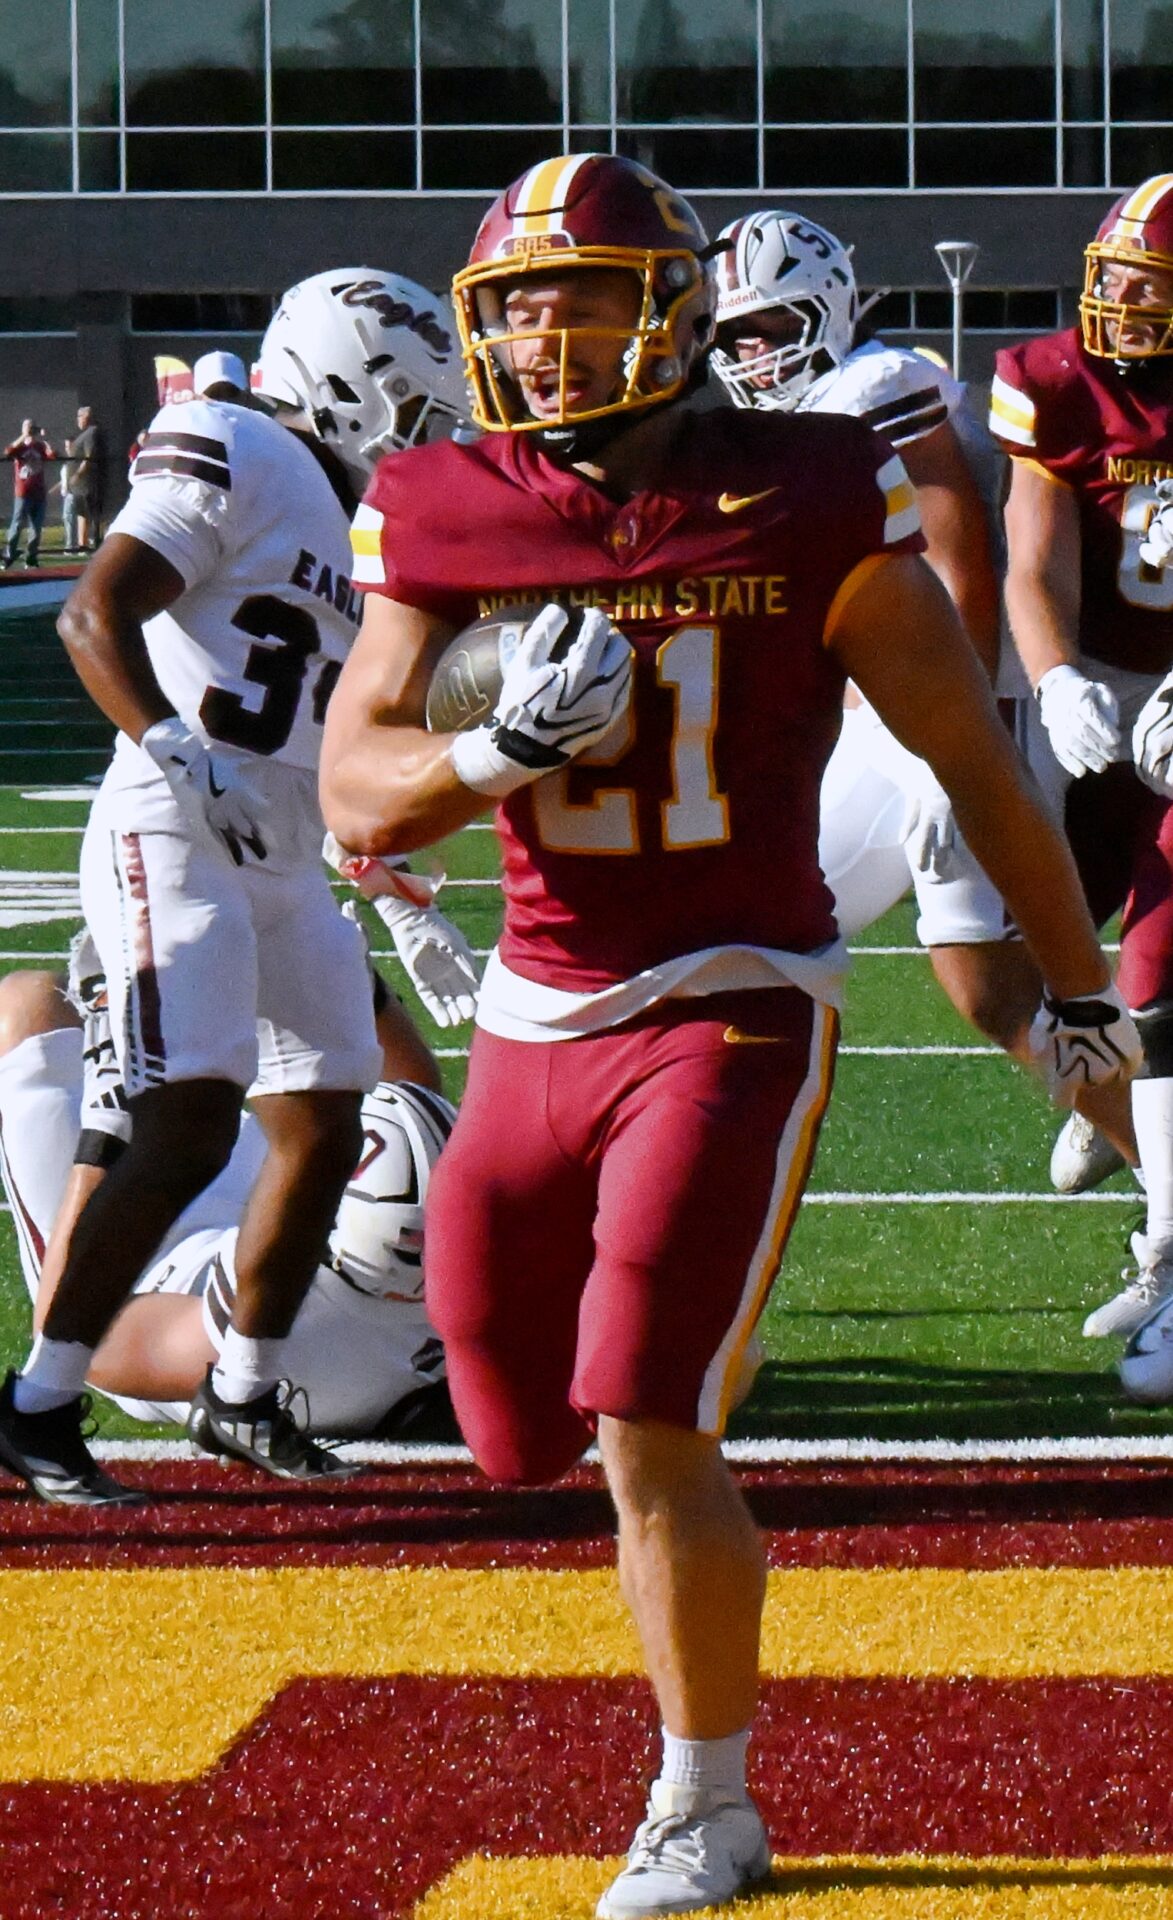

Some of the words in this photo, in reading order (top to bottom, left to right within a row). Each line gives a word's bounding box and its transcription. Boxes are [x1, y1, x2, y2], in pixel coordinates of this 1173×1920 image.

[717, 290, 758, 312] Riddell
[289, 549, 366, 629] EAGL
[675, 575, 788, 617] STATE
[533, 623, 731, 856] 21
